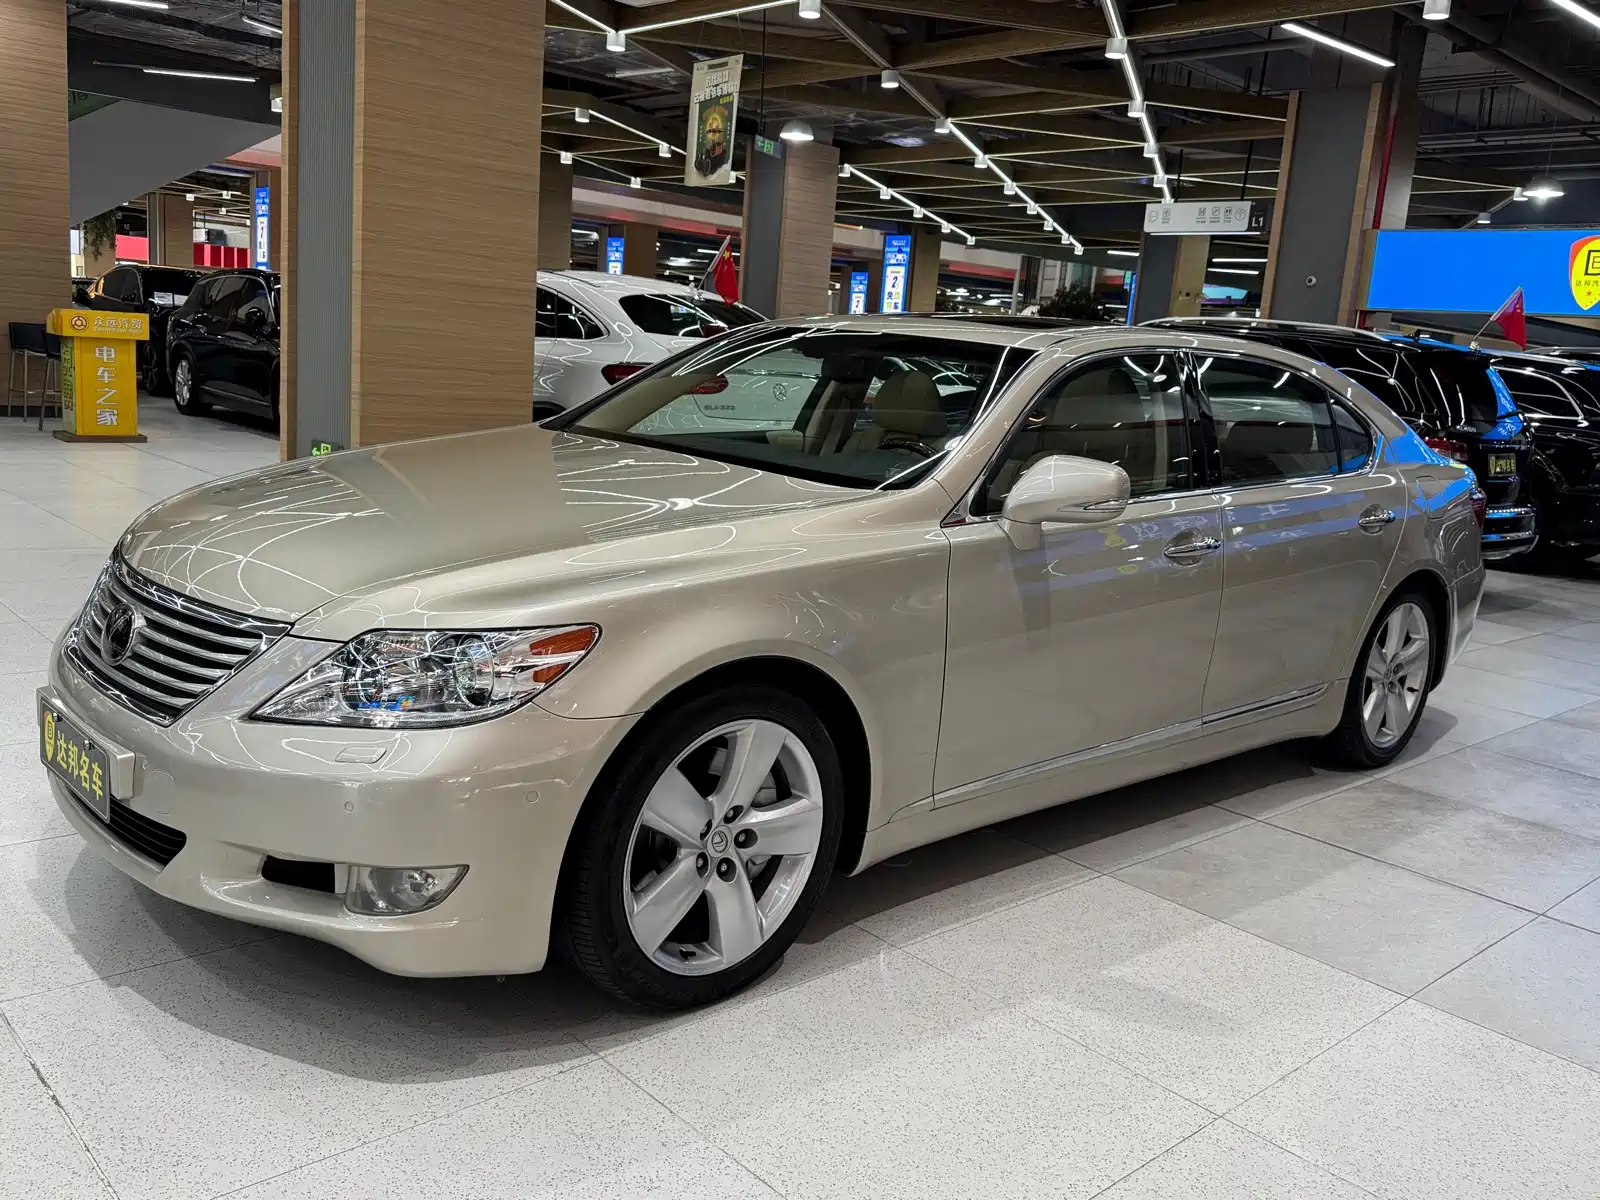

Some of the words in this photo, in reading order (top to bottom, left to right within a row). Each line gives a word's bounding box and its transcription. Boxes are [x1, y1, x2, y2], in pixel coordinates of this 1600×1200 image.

[1251, 216, 1264, 227] L1
[95, 345, 118, 426] 电车之家
[56, 730, 103, 801] 达邦名车
